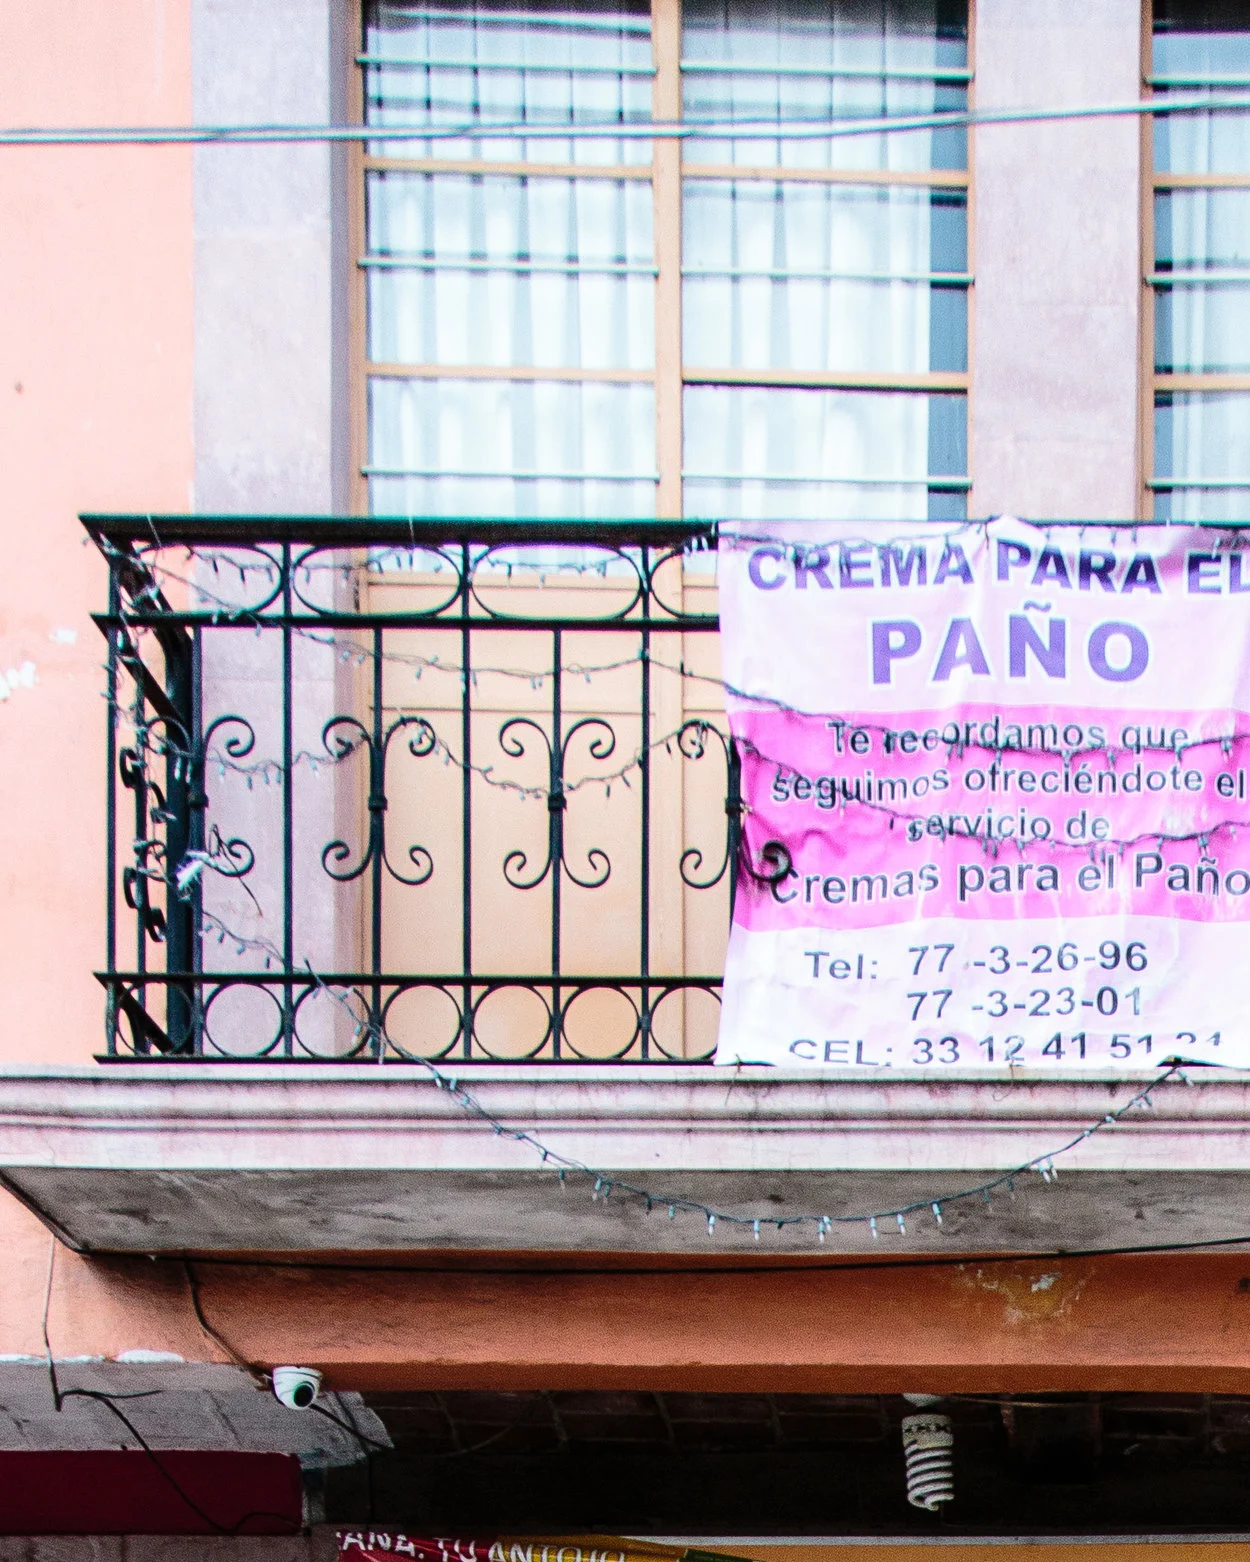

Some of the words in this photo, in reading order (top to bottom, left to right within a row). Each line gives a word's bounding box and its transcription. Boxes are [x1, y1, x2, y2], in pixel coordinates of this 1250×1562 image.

[748, 543, 973, 591] CREMA
[996, 539, 1163, 594] PARA
[870, 600, 1150, 684] PAÑO
[827, 721, 870, 754] Te
[884, 716, 1106, 753] recordamos
[1121, 724, 1189, 753] que
[773, 766, 949, 809] seguimos
[965, 762, 1202, 795] ofreciéndote
[1217, 769, 1245, 799] el
[907, 807, 1051, 841] servicio
[1066, 810, 1110, 840] de
[770, 862, 940, 903] Cremas
[958, 861, 1059, 900] para
[1077, 853, 1115, 891] el
[1135, 850, 1250, 896] Paño
[805, 951, 879, 980] Tel:
[789, 1039, 892, 1066] CEL:
[912, 1037, 960, 1064] 33
[978, 1035, 1026, 1061] 12
[1041, 1034, 1087, 1060] 41
